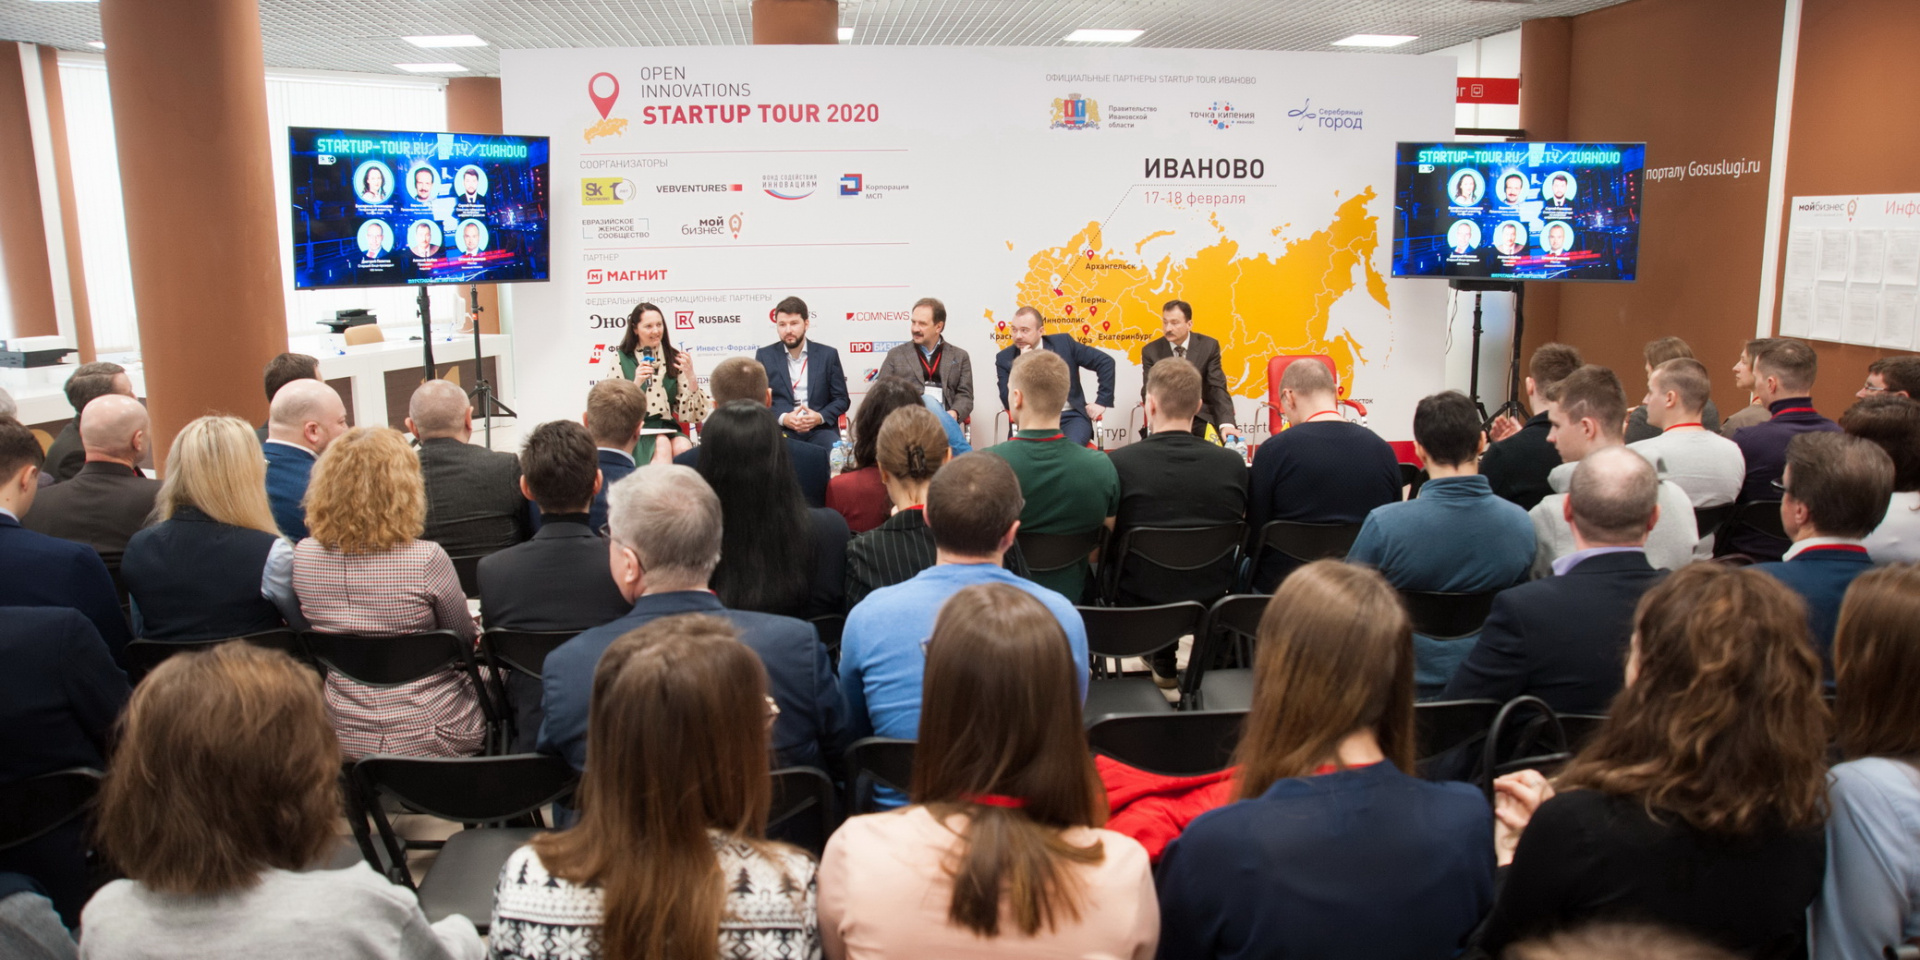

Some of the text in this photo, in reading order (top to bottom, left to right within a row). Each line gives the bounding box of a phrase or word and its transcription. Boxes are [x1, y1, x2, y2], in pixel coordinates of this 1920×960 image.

[640, 66, 686, 81] OPEN
[1045, 73, 1257, 85] ОФИЦИАЛЬНЫЕ ПАРТНЕРЫ STARTUP TOUR ИВАНОВО
[641, 83, 751, 98] INNOVATIONS
[642, 103, 879, 124] STARTUP TOUR 2020
[1108, 105, 1157, 113] Правительство
[1319, 108, 1363, 116] Серебряный
[1319, 117, 1362, 131] город
[579, 158, 668, 170] СООРГАНИЗАТОРЫ
[1144, 158, 1265, 179] ИВАНОВО
[1646, 157, 1761, 182] порталу Gosuslugi.ru
[780, 173, 817, 181] СОДЕЙСТВИЯ
[585, 182, 603, 196] Sk
[656, 184, 727, 193] VEBVENTURES
[762, 181, 818, 189] ИННОВАЦИЯМ
[1144, 190, 1246, 208] 17-18 февраля
[582, 217, 634, 226] ЕВРАЗИЙСКОЕ
[699, 216, 724, 226] мой
[681, 224, 725, 235] бизнес
[583, 253, 619, 262] ПАРТНЕР
[1085, 262, 1136, 270] Архангельск
[607, 269, 668, 282] МАГНИТ
[585, 294, 772, 306] ФЕДЕРАЛЬНЫЕ ИНФОРМАЦИОННЫЕ ПАРТНЕРЫ
[1080, 296, 1107, 304] Пермь
[698, 315, 741, 324] RUSBASE
[856, 311, 910, 321] COMNEWS
[1077, 336, 1093, 345] Уфа
[1098, 332, 1153, 342] Екатеринбург
[696, 343, 760, 352] Инвест-Форсайт
[851, 343, 872, 352] ПРО
